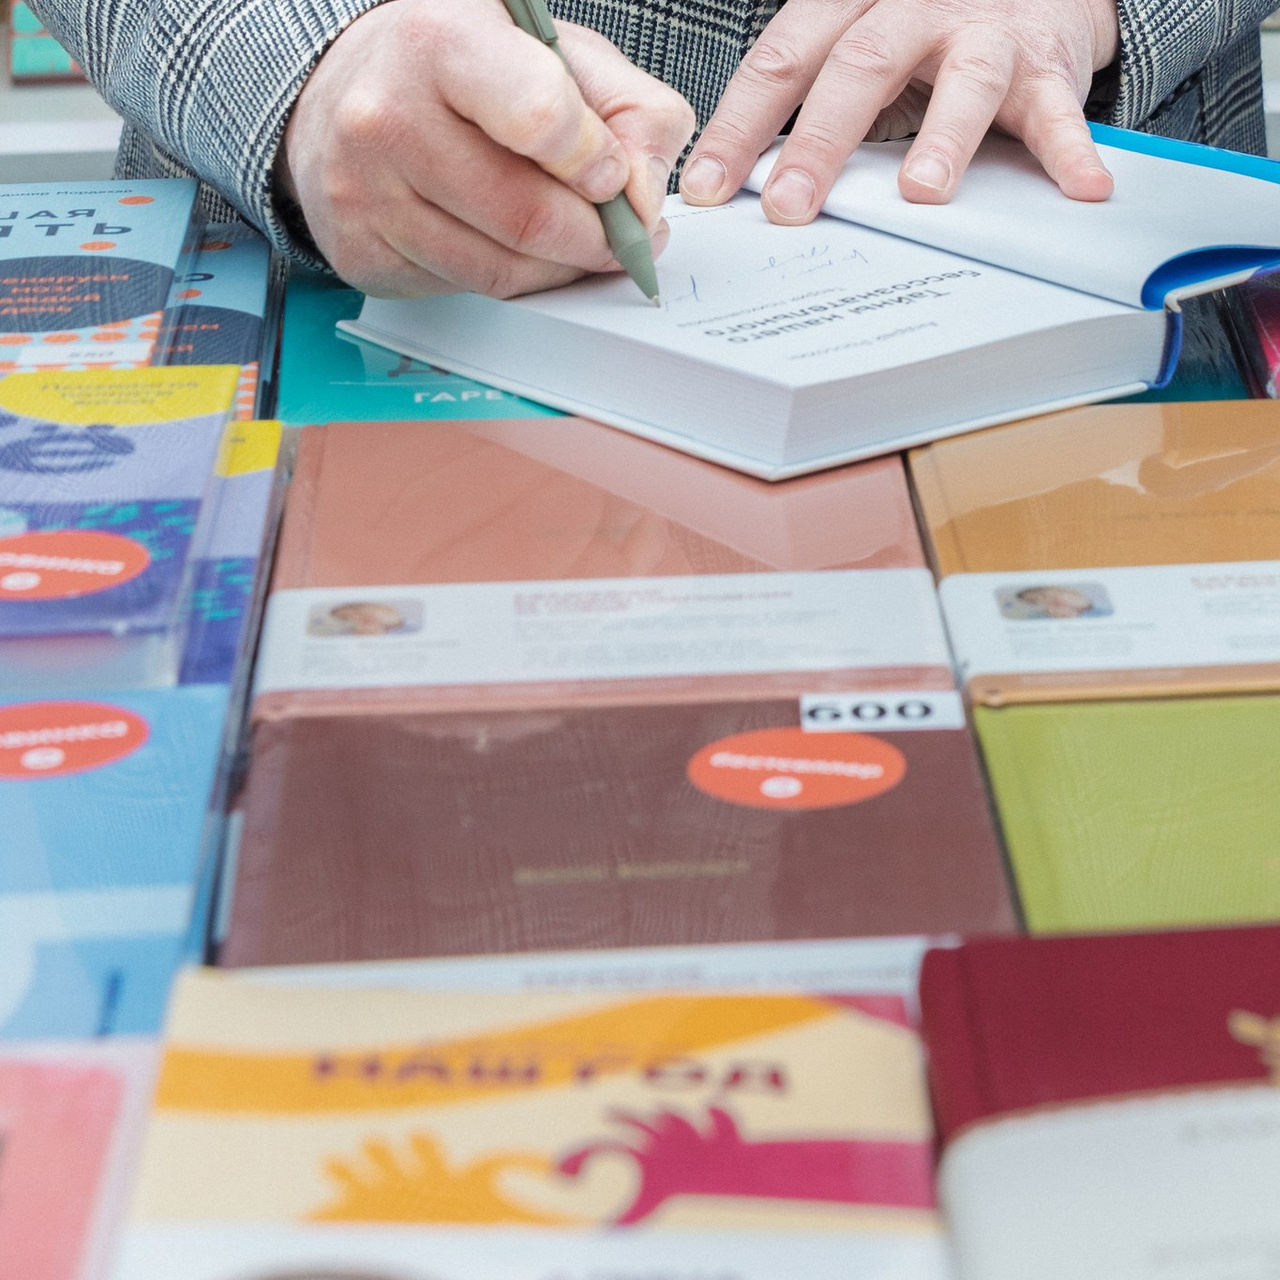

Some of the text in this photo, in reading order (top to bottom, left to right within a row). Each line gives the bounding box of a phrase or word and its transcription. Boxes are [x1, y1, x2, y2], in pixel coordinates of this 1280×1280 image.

[702, 269, 982, 339] бессознательного
[725, 288, 952, 346] Тайны нашего
[413, 390, 514, 404] ГАРЕ
[805, 699, 933, 722] 600
